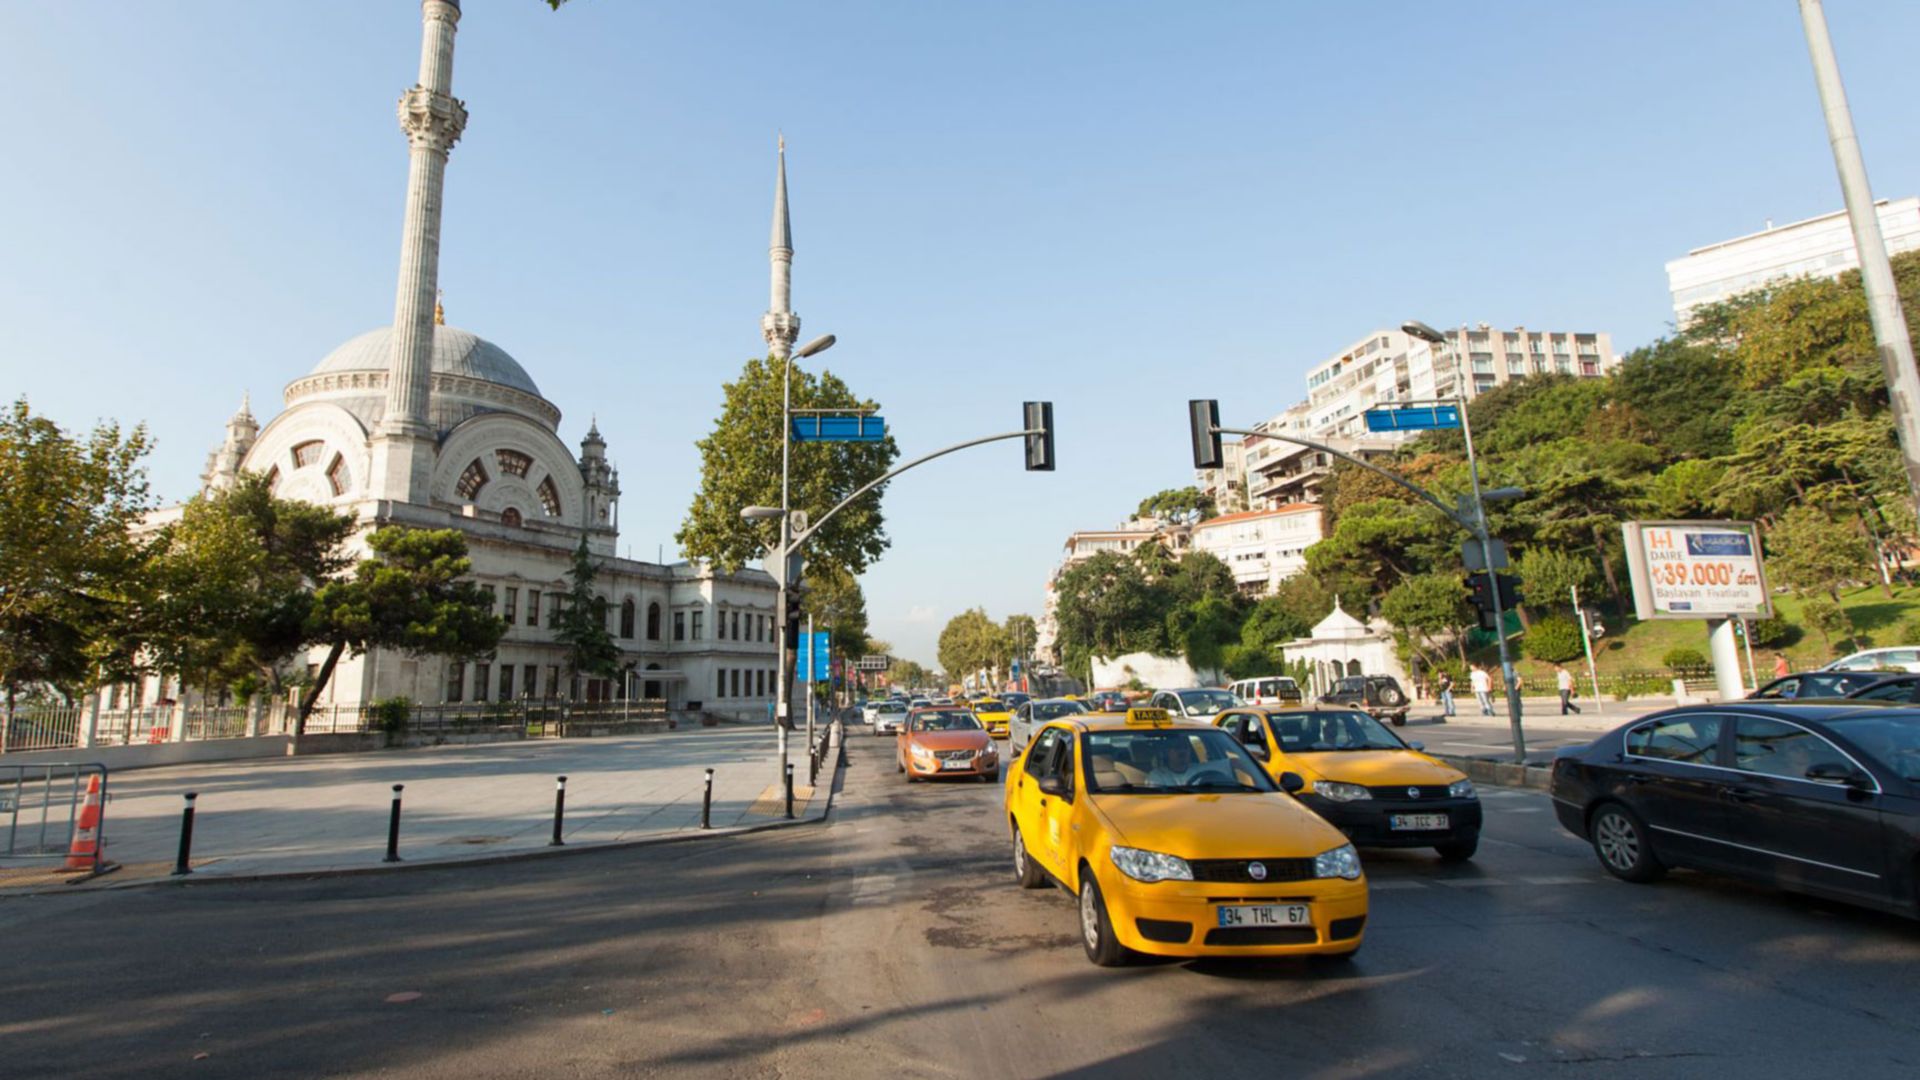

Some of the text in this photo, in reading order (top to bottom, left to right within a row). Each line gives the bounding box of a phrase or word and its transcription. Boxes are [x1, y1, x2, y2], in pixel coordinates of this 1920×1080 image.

[1396, 816, 1407, 827] 34
[1436, 815, 1446, 827] 37
[1226, 906, 1305, 924] 34 THL 67
